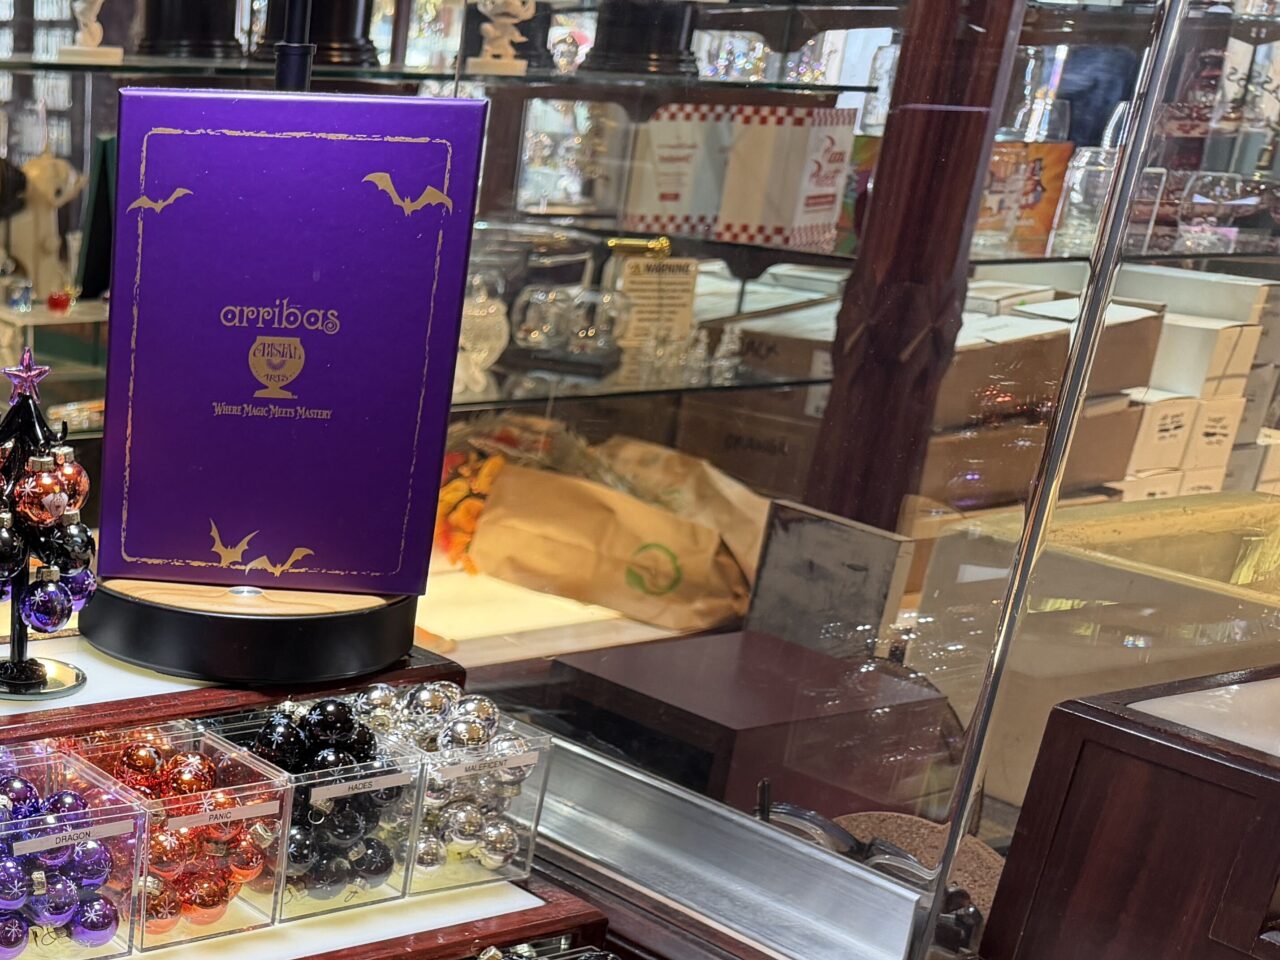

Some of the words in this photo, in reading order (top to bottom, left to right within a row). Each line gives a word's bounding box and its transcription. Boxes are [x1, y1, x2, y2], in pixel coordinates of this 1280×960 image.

[220, 297, 341, 335] arribas
[252, 342, 302, 361] CRISTAL
[263, 373, 289, 383] ARTS
[212, 402, 242, 417] WHERE
[242, 403, 268, 418] MAGIC
[269, 404, 295, 419] MEETS
[295, 406, 333, 421] MASTERY
[464, 759, 508, 773] MALEFICENT
[348, 781, 373, 792] HADES
[208, 811, 232, 822] PANIC
[55, 831, 91, 845] DRAGON
